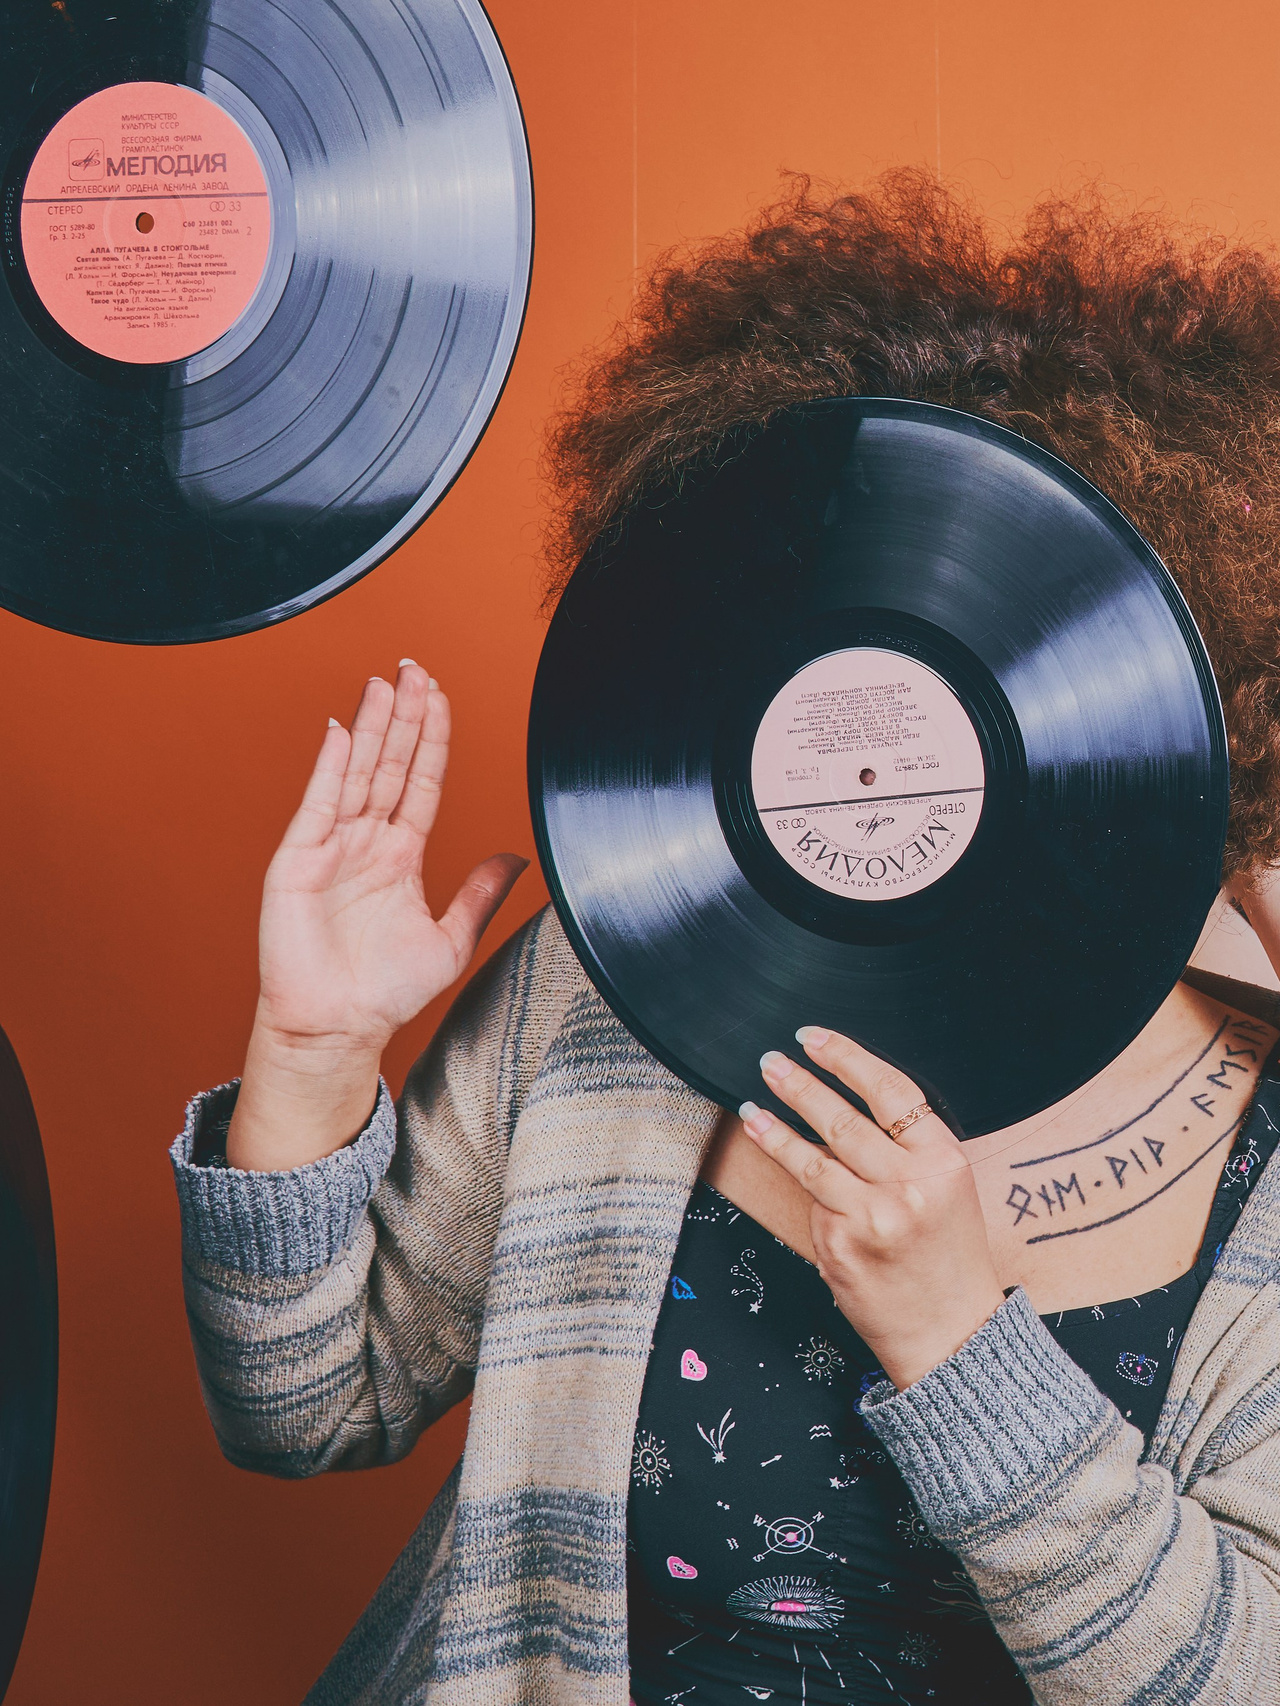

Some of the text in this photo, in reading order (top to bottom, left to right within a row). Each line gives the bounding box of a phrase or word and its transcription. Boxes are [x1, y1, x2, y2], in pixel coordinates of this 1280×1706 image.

[122, 144, 183, 152] ГРАМПЛАСТИНОК
[106, 154, 226, 176] МЕЛОДИЯ
[60, 181, 229, 193] АПРЕЛЕВСКИЙ ОРДЕНА ЛЕНИНА ЗАВОД
[47, 205, 83, 214] СТЕРЕО
[228, 201, 241, 210] 33
[246, 226, 251, 235] 2
[865, 682, 904, 691] ВЕЧЕРИНКА
[822, 687, 862, 696] КОНЧИЛАСЬ
[840, 692, 867, 700] СОЛНЦУ
[837, 704, 872, 712] РОБИНСОН
[887, 704, 917, 712] ЭЛЕОНОР
[863, 724, 892, 732] ЛЕТНЮЮ
[871, 740, 902, 748] ТАНЦУЕМ
[817, 746, 853, 754] ПЕРЕРЫВА
[885, 798, 931, 806] АПРЕЛЕВСКИЙ
[929, 802, 965, 815] СТЕРЕО
[776, 820, 788, 829] 33
[797, 818, 950, 879] МЕЛОДИЯ
[792, 832, 957, 887] МИНИСТЕРСТВО КУЛЬТУРЫ СССР
